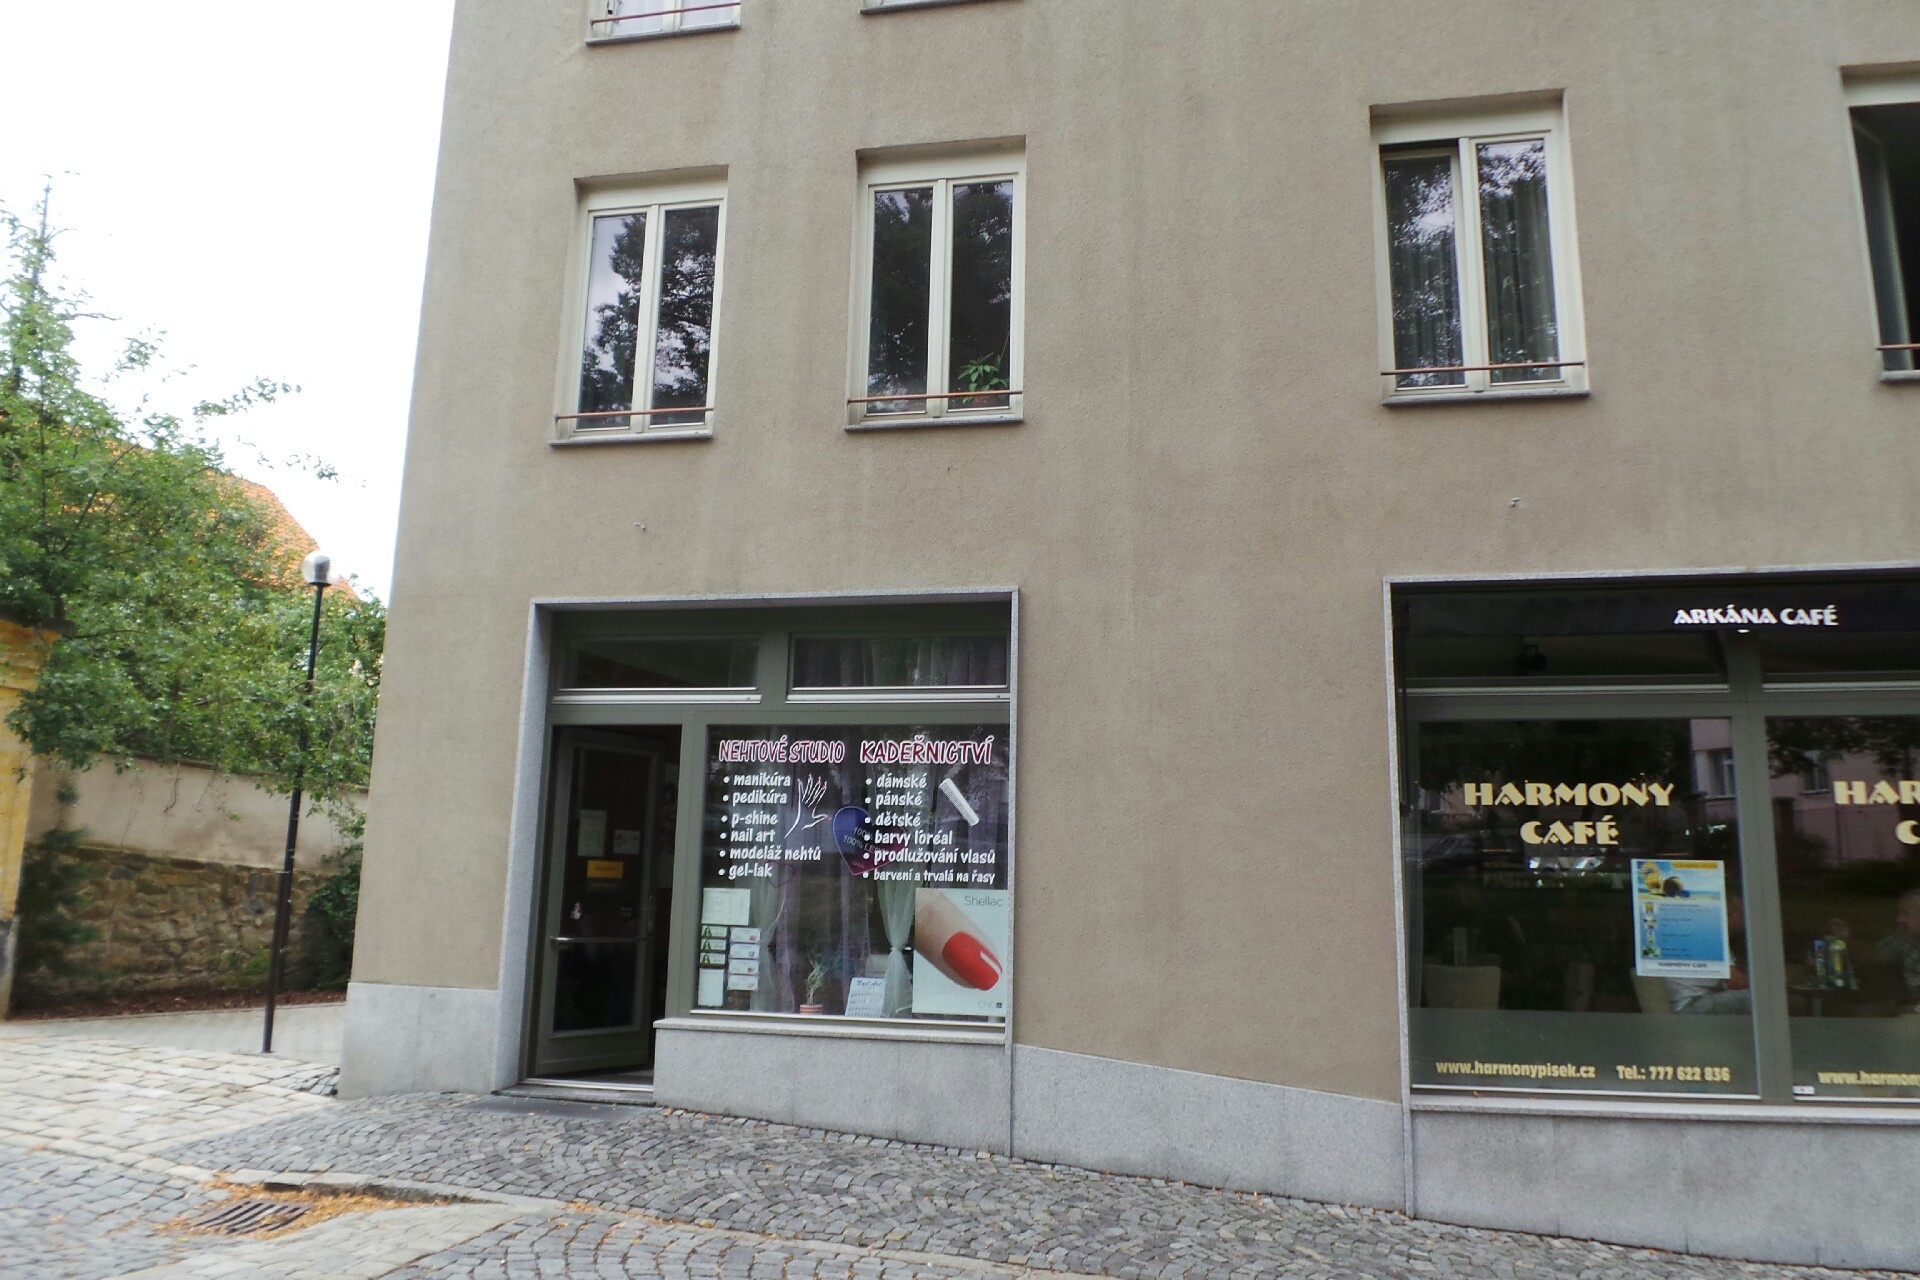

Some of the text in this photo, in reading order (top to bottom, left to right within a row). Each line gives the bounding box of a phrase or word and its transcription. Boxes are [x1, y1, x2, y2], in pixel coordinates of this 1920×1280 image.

[1674, 604, 1839, 626] ARKÁNA CAFÉ
[719, 734, 846, 764] NEHTOVÉ STUDIO
[860, 734, 995, 764] KADEŘNICTVÍ
[733, 772, 791, 787] manikúra
[876, 772, 927, 789] dámské
[732, 788, 788, 807] pedikúra
[875, 790, 923, 810] pánské
[1463, 782, 1675, 806] HARMONY
[731, 810, 778, 828] p-shine
[875, 811, 922, 827] dětské
[730, 828, 776, 842] nail art
[874, 829, 911, 847] barvy
[1519, 814, 1620, 845] CAFÉ
[729, 844, 821, 861] modeláž nehtů
[874, 847, 996, 866] prodlužování vlasů
[728, 862, 773, 880] gel-lak
[873, 868, 996, 885] barvení a trvalá na řasy
[964, 895, 1004, 907] Shellac
[1435, 1061, 1596, 1079] www.harmonypisek.cz
[1616, 1064, 1646, 1080] Tel.:
[1648, 1065, 1674, 1081] 777
[1676, 1065, 1702, 1082] 622
